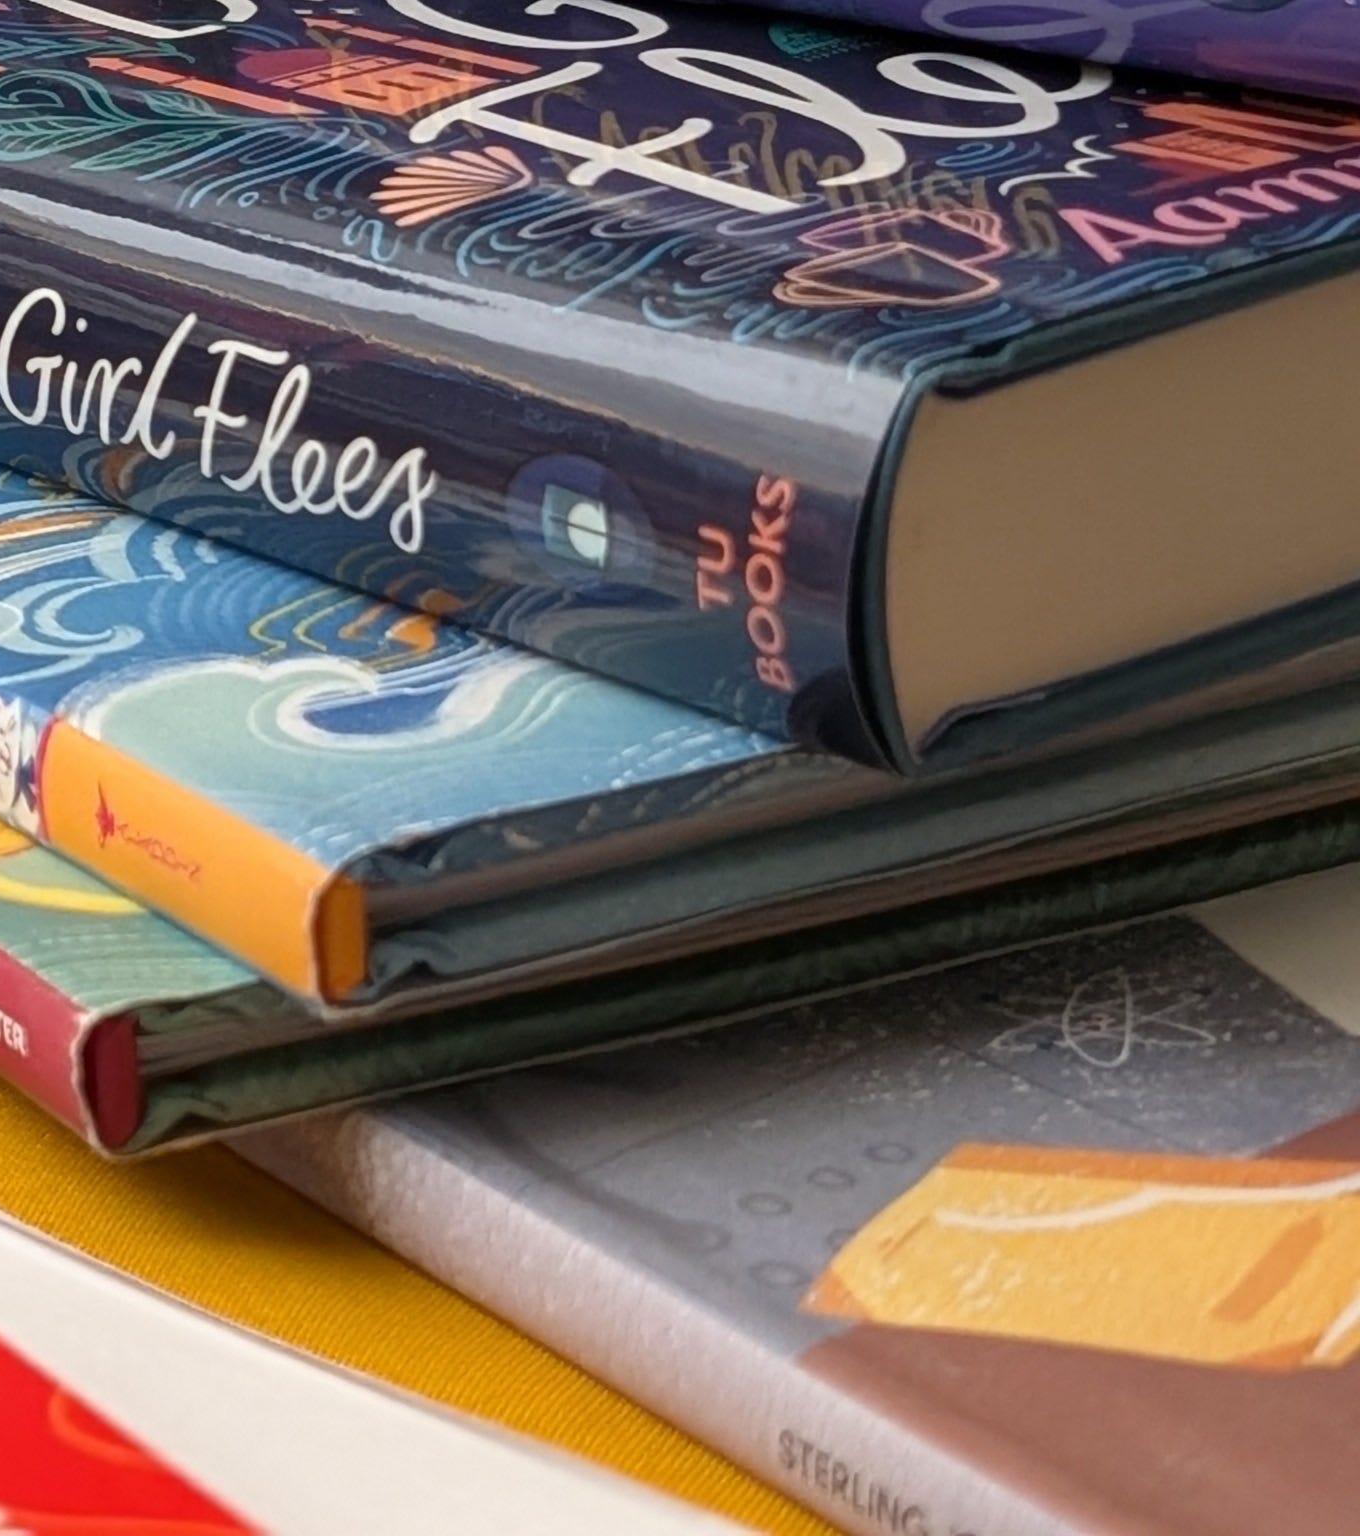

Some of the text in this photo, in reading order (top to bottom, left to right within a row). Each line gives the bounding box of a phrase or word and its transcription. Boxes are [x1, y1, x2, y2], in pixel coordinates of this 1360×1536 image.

[192, 339, 437, 554] Flees
[696, 524, 736, 612] TU
[745, 474, 797, 693] BOOKS
